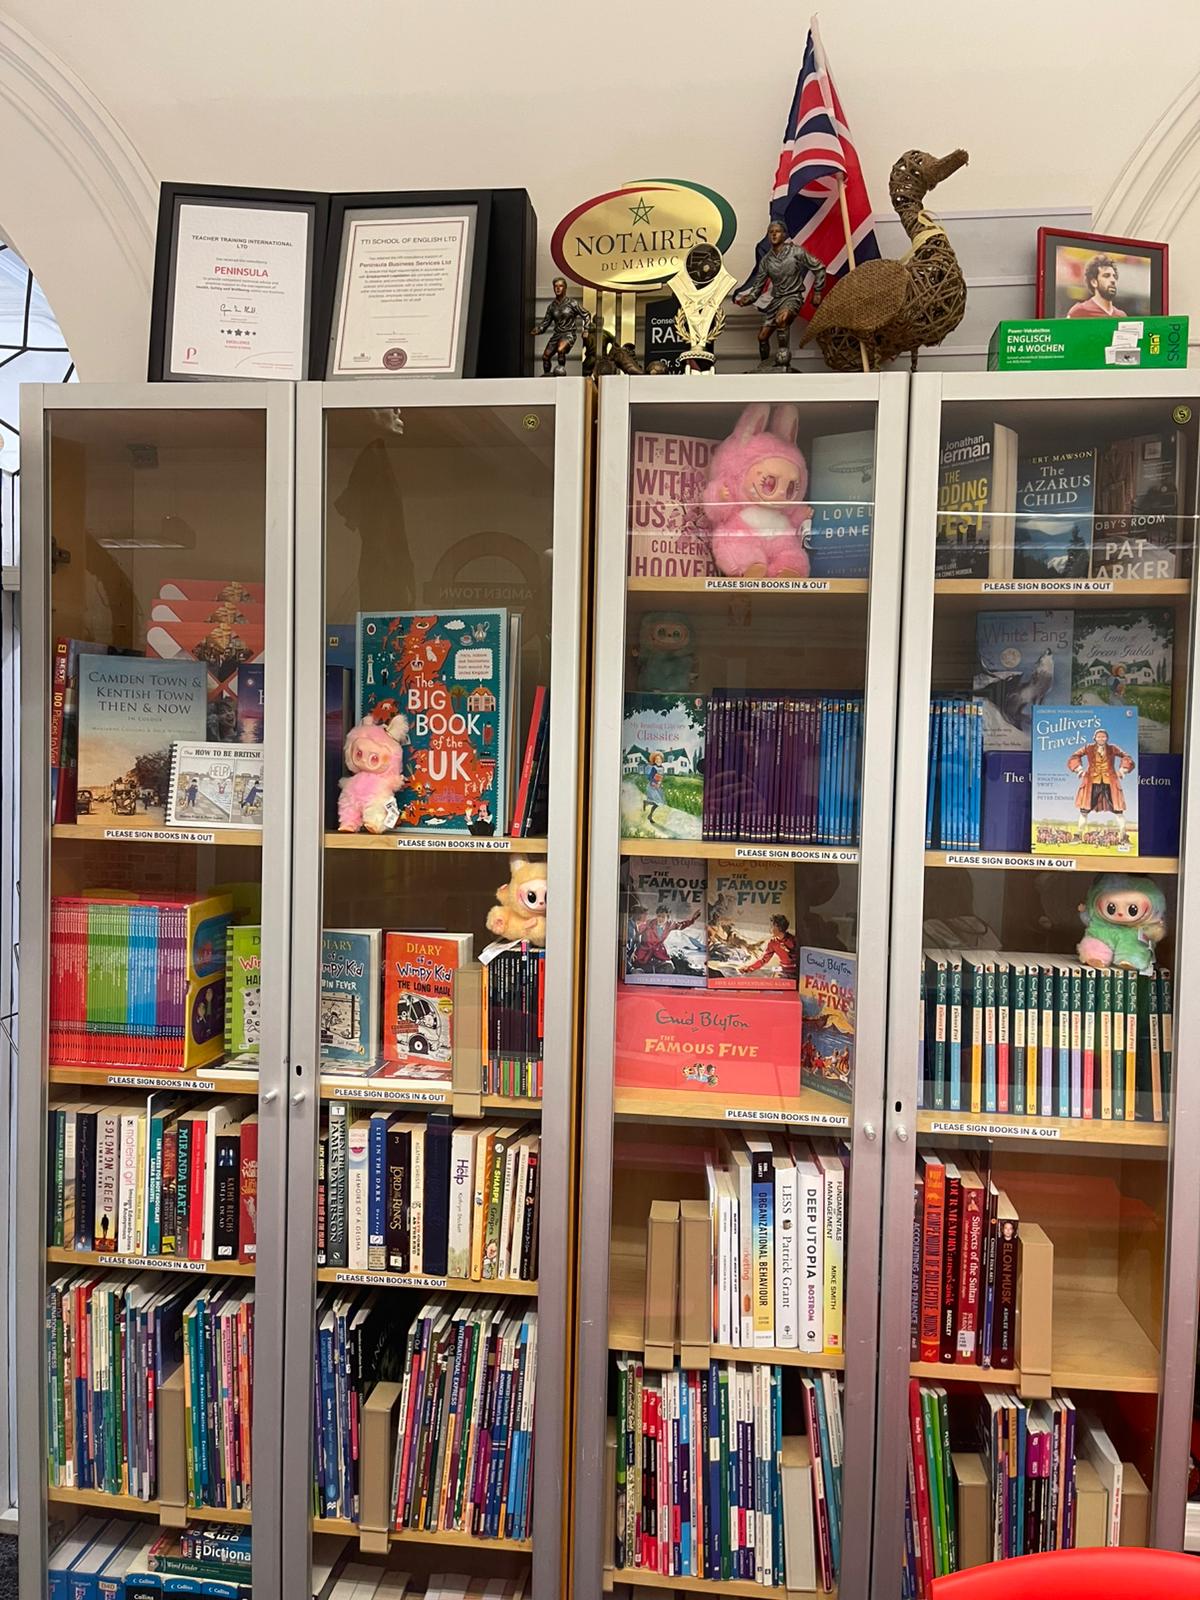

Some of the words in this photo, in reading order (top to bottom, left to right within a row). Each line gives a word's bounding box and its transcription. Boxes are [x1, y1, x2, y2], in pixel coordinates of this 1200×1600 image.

[576, 228, 708, 257] NOTAIRES
[214, 266, 268, 277] PENINSULA
[601, 262, 618, 272] DU
[622, 256, 679, 270] MAROC
[1008, 334, 1051, 343] ENGLISCH
[1025, 344, 1064, 352] WOCHEN
[1167, 323, 1181, 361] PONS
[638, 436, 658, 463] IT
[945, 435, 984, 451] Jonathan
[1052, 451, 1092, 462] MAWSON
[945, 470, 960, 484] THE
[1040, 466, 1065, 476] The
[636, 468, 696, 500] WITH
[1024, 491, 1078, 507] CHILD
[636, 500, 666, 528] US
[1096, 519, 1126, 530] OBY'S
[1131, 515, 1165, 526] ROOM
[826, 525, 869, 538] BONE
[652, 540, 709, 555] COLLEEN
[1105, 539, 1147, 560] PAT
[1096, 560, 1169, 578] ARKER
[982, 623, 1028, 644] White
[1032, 622, 1068, 649] Fang
[89, 671, 144, 685] CAMDEN
[150, 675, 187, 687] TOWN
[192, 677, 201, 688] &
[415, 673, 434, 688] The
[97, 687, 151, 699] KENTISH
[156, 689, 194, 701] TOWN
[407, 690, 447, 710] BIG
[99, 701, 137, 712] THEN
[143, 703, 152, 712] &
[158, 704, 191, 714] NOW
[416, 714, 481, 736] BOOK
[1037, 714, 1101, 734] Gulliver's
[433, 737, 444, 749] of
[446, 737, 463, 748] the
[636, 729, 680, 742] Classics
[1037, 731, 1087, 751] Travels
[427, 750, 470, 782] UK
[1004, 772, 1024, 783] The
[948, 856, 980, 864] PLEASE
[981, 857, 1003, 865] SIGN
[1005, 858, 1035, 866] BOOKS
[1055, 860, 1073, 868] OUT
[717, 877, 788, 891] FAMOUS
[737, 892, 782, 906] FIVE
[407, 943, 442, 956] DIARY
[396, 962, 432, 982] Wimpy
[434, 965, 452, 982] Kid
[398, 980, 410, 989] THE
[414, 982, 431, 992] LONG
[434, 984, 451, 996] HAUL
[656, 1008, 694, 1025] Enid
[700, 1012, 749, 1030] Blyton
[644, 1038, 714, 1055] FAMOUS
[718, 1043, 759, 1057] FIVE
[108, 1077, 135, 1085] PLEASE
[136, 1078, 155, 1086] SIGN
[156, 1079, 181, 1088] BOOKS
[727, 1110, 758, 1120] PLEASE
[759, 1112, 779, 1121] SIGN
[781, 1113, 810, 1122] BOOKS
[811, 1115, 820, 1123] IN
[829, 1116, 846, 1124] OUT
[104, 1120, 114, 1170] SOLOMON
[330, 1121, 339, 1164] JAMES
[178, 1128, 188, 1181] MIRANDA
[454, 1159, 469, 1185] Help
[103, 1176, 114, 1213] CREED
[492, 1170, 500, 1204] SHARPE
[177, 1184, 186, 1216] HART
[330, 1168, 339, 1242] PATTERSON
[783, 1185, 792, 1214] LESS
[807, 1189, 816, 1222] DEEP
[758, 1192, 769, 1259] ORGANIZATIONAL
[970, 1216, 980, 1249] Subjects
[783, 1236, 792, 1273] Patrick
[806, 1226, 816, 1279] UTOPIA
[912, 1222, 920, 1272] ACCOUNTING
[970, 1252, 979, 1261] of
[1002, 1242, 1012, 1272] ELON
[970, 1263, 978, 1276] the
[337, 1274, 365, 1283] PLEASE
[366, 1276, 385, 1284] SIGN
[386, 1277, 412, 1286] BOOKS
[430, 1279, 446, 1287] OUT
[759, 1262, 769, 1306] BEHAVIOUR
[1002, 1274, 1012, 1304] MUSK
[782, 1277, 792, 1308] Grant
[968, 1278, 978, 1304] Sultan
[453, 1325, 465, 1375] INTERNATIONAL
[450, 1377, 460, 1406] EXPRESS
[202, 1544, 251, 1562] Dictiona
